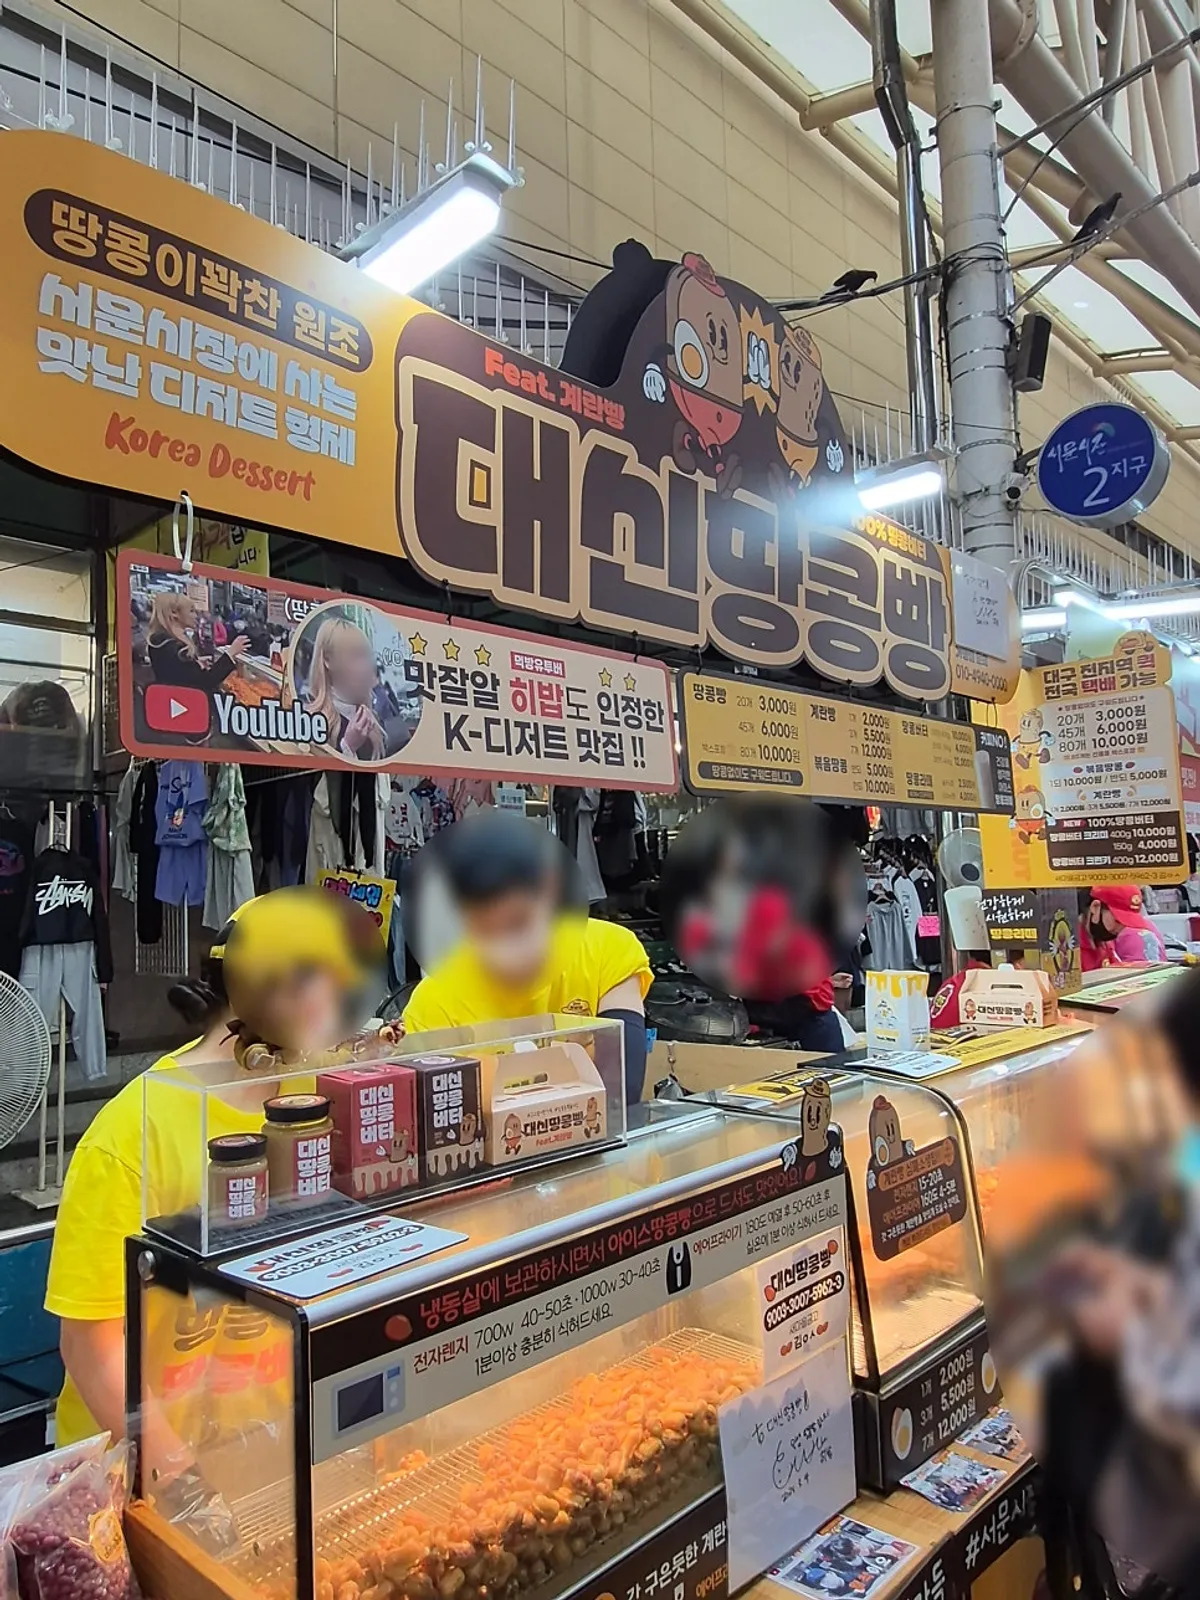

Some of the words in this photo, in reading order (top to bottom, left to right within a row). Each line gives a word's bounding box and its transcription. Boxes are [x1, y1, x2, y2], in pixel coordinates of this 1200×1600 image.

[293, 302, 360, 364] 원조
[39, 272, 278, 391] 서문시장에
[285, 360, 357, 421] 사는
[37, 326, 142, 398] 맛난
[150, 361, 278, 440] 디저트
[285, 406, 356, 466] 형제
[484, 347, 555, 402] Feat.
[559, 380, 625, 430] 계란빵
[105, 411, 201, 468] Korea
[208, 443, 316, 501] Dessert
[410, 373, 948, 692] 대신땅콩빵
[514, 655, 563, 676] 먹방유투버
[1043, 667, 1077, 684] 대구
[1080, 657, 1134, 678] 전지역
[1137, 653, 1156, 669] 퀵
[404, 659, 501, 710] 맛잘알
[510, 677, 590, 721] 히밥도
[597, 690, 665, 734] 인정한
[1044, 684, 1078, 700] 전국
[1081, 676, 1116, 694] 택배
[1120, 672, 1156, 689] 가능
[693, 683, 726, 705] 땅콩빵
[759, 695, 797, 716] 3,000원
[213, 693, 328, 743] YouTube
[810, 704, 836, 722] 계란빵
[1057, 713, 1084, 726] 20개
[1096, 705, 1146, 721] 3,000원
[444, 712, 569, 760] K-디저트
[576, 730, 624, 767] 맛집
[761, 720, 798, 740] 6,000원
[1058, 727, 1085, 739] 45개
[1097, 719, 1147, 735] 6,000원
[1059, 740, 1086, 752] 80개
[1091, 732, 1148, 749] 10,000원
[758, 744, 800, 764] 10,000원
[1063, 776, 1102, 787] 10,000원
[1129, 769, 1167, 780] 5,000원
[1086, 762, 1123, 773] 볶음땅콩
[1093, 789, 1121, 799] 계란빵
[1110, 830, 1132, 840] 400g
[1132, 826, 1176, 838] 10,000원
[1138, 838, 1177, 849] 4,000원
[1112, 856, 1134, 865] 400g
[1134, 852, 1178, 863] 12,000원
[975, 895, 1025, 911] 건강하게
[986, 908, 1034, 924] 시원하게
[360, 1083, 394, 1106] 대신
[432, 1071, 462, 1092] 대신
[433, 1106, 463, 1128] 버터
[523, 1111, 584, 1137] 대신땅콩빵
[360, 1121, 394, 1144] 버터
[297, 1135, 331, 1158] 대신
[298, 1173, 331, 1196] 버터
[693, 1225, 743, 1255] 에어프라이기
[420, 1277, 500, 1329] 냉동실에
[504, 1243, 605, 1298] 보관하시면서
[607, 1198, 718, 1256] 아이스땅콩빵으로
[770, 1248, 832, 1292] 대신땅콩빵
[413, 1335, 470, 1374] 전자렌지
[474, 1321, 514, 1349] 700w
[521, 1294, 573, 1329] 40~50초
[475, 1345, 517, 1376] 1분이상
[520, 1326, 557, 1358] 충분히
[921, 1379, 932, 1398] 1개
[939, 1347, 974, 1387] 2,000원
[920, 1405, 933, 1427] 3개
[940, 1372, 975, 1411] 5,500원
[922, 1432, 934, 1452] 7개
[938, 1397, 976, 1440] 12,000원
[645, 1541, 698, 1597] 구운듯한
